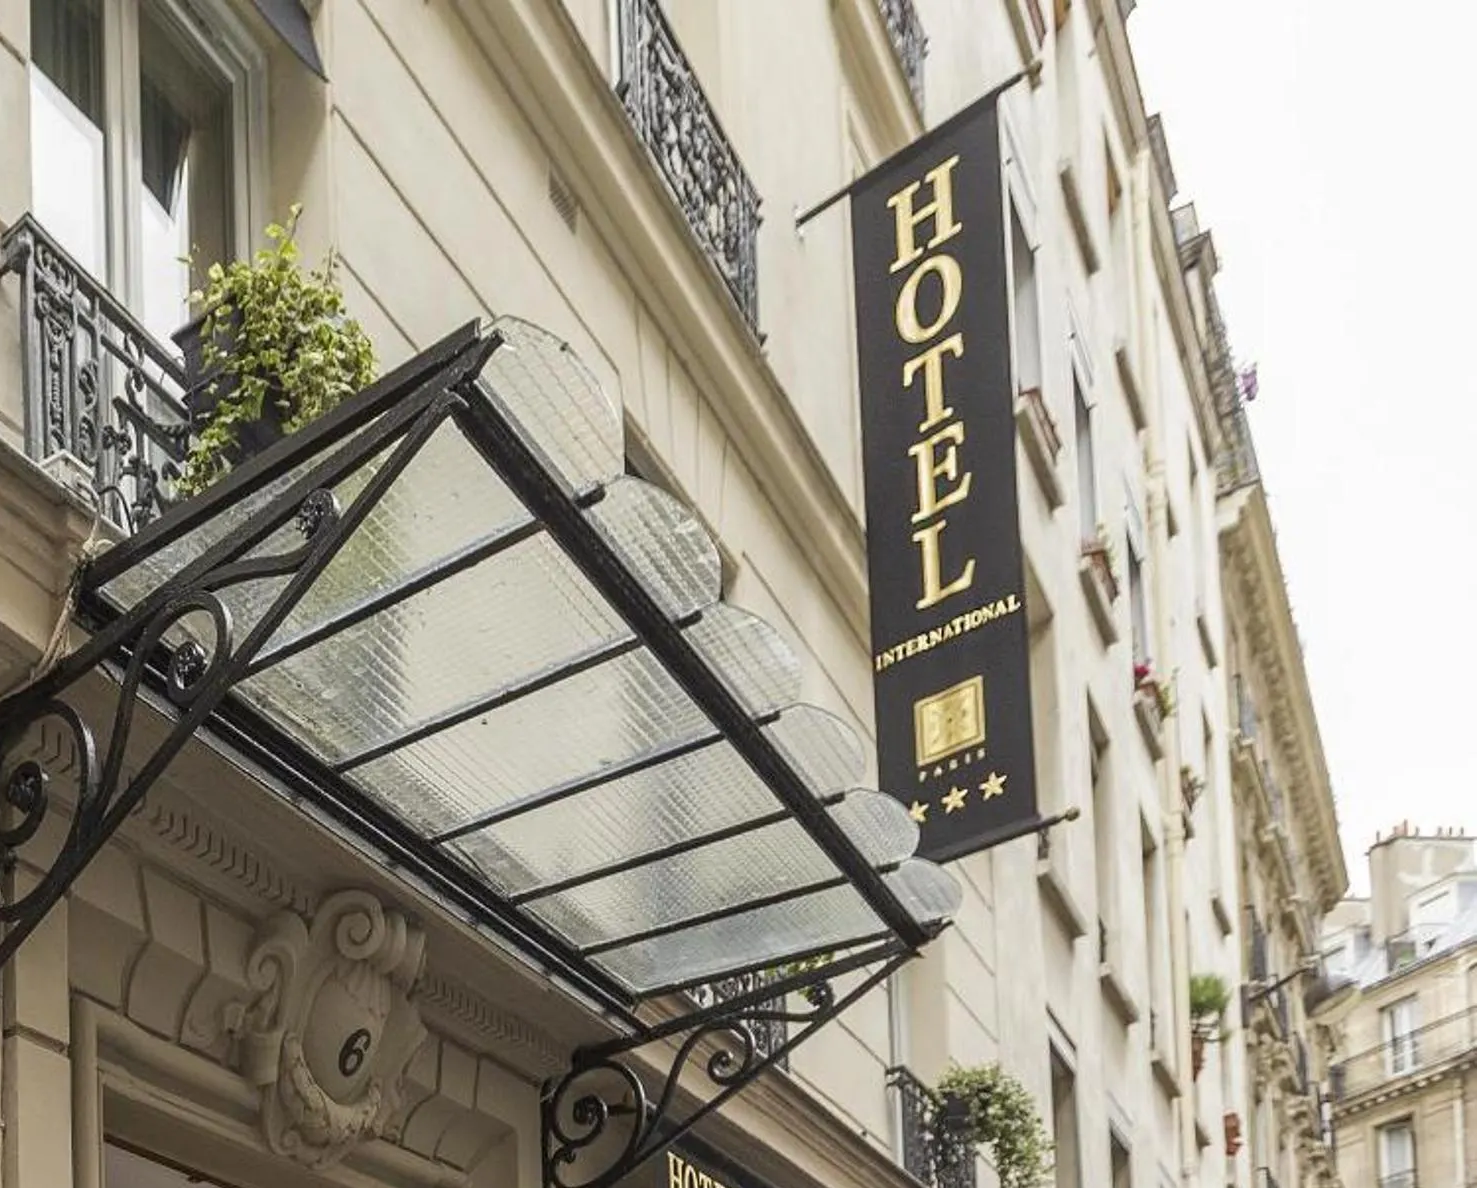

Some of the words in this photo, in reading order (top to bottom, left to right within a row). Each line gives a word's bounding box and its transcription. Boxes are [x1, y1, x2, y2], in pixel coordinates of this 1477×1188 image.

[886, 154, 975, 609] HOTEL
[875, 593, 1021, 672] INTERNATIONAL
[338, 1028, 371, 1077] 6
